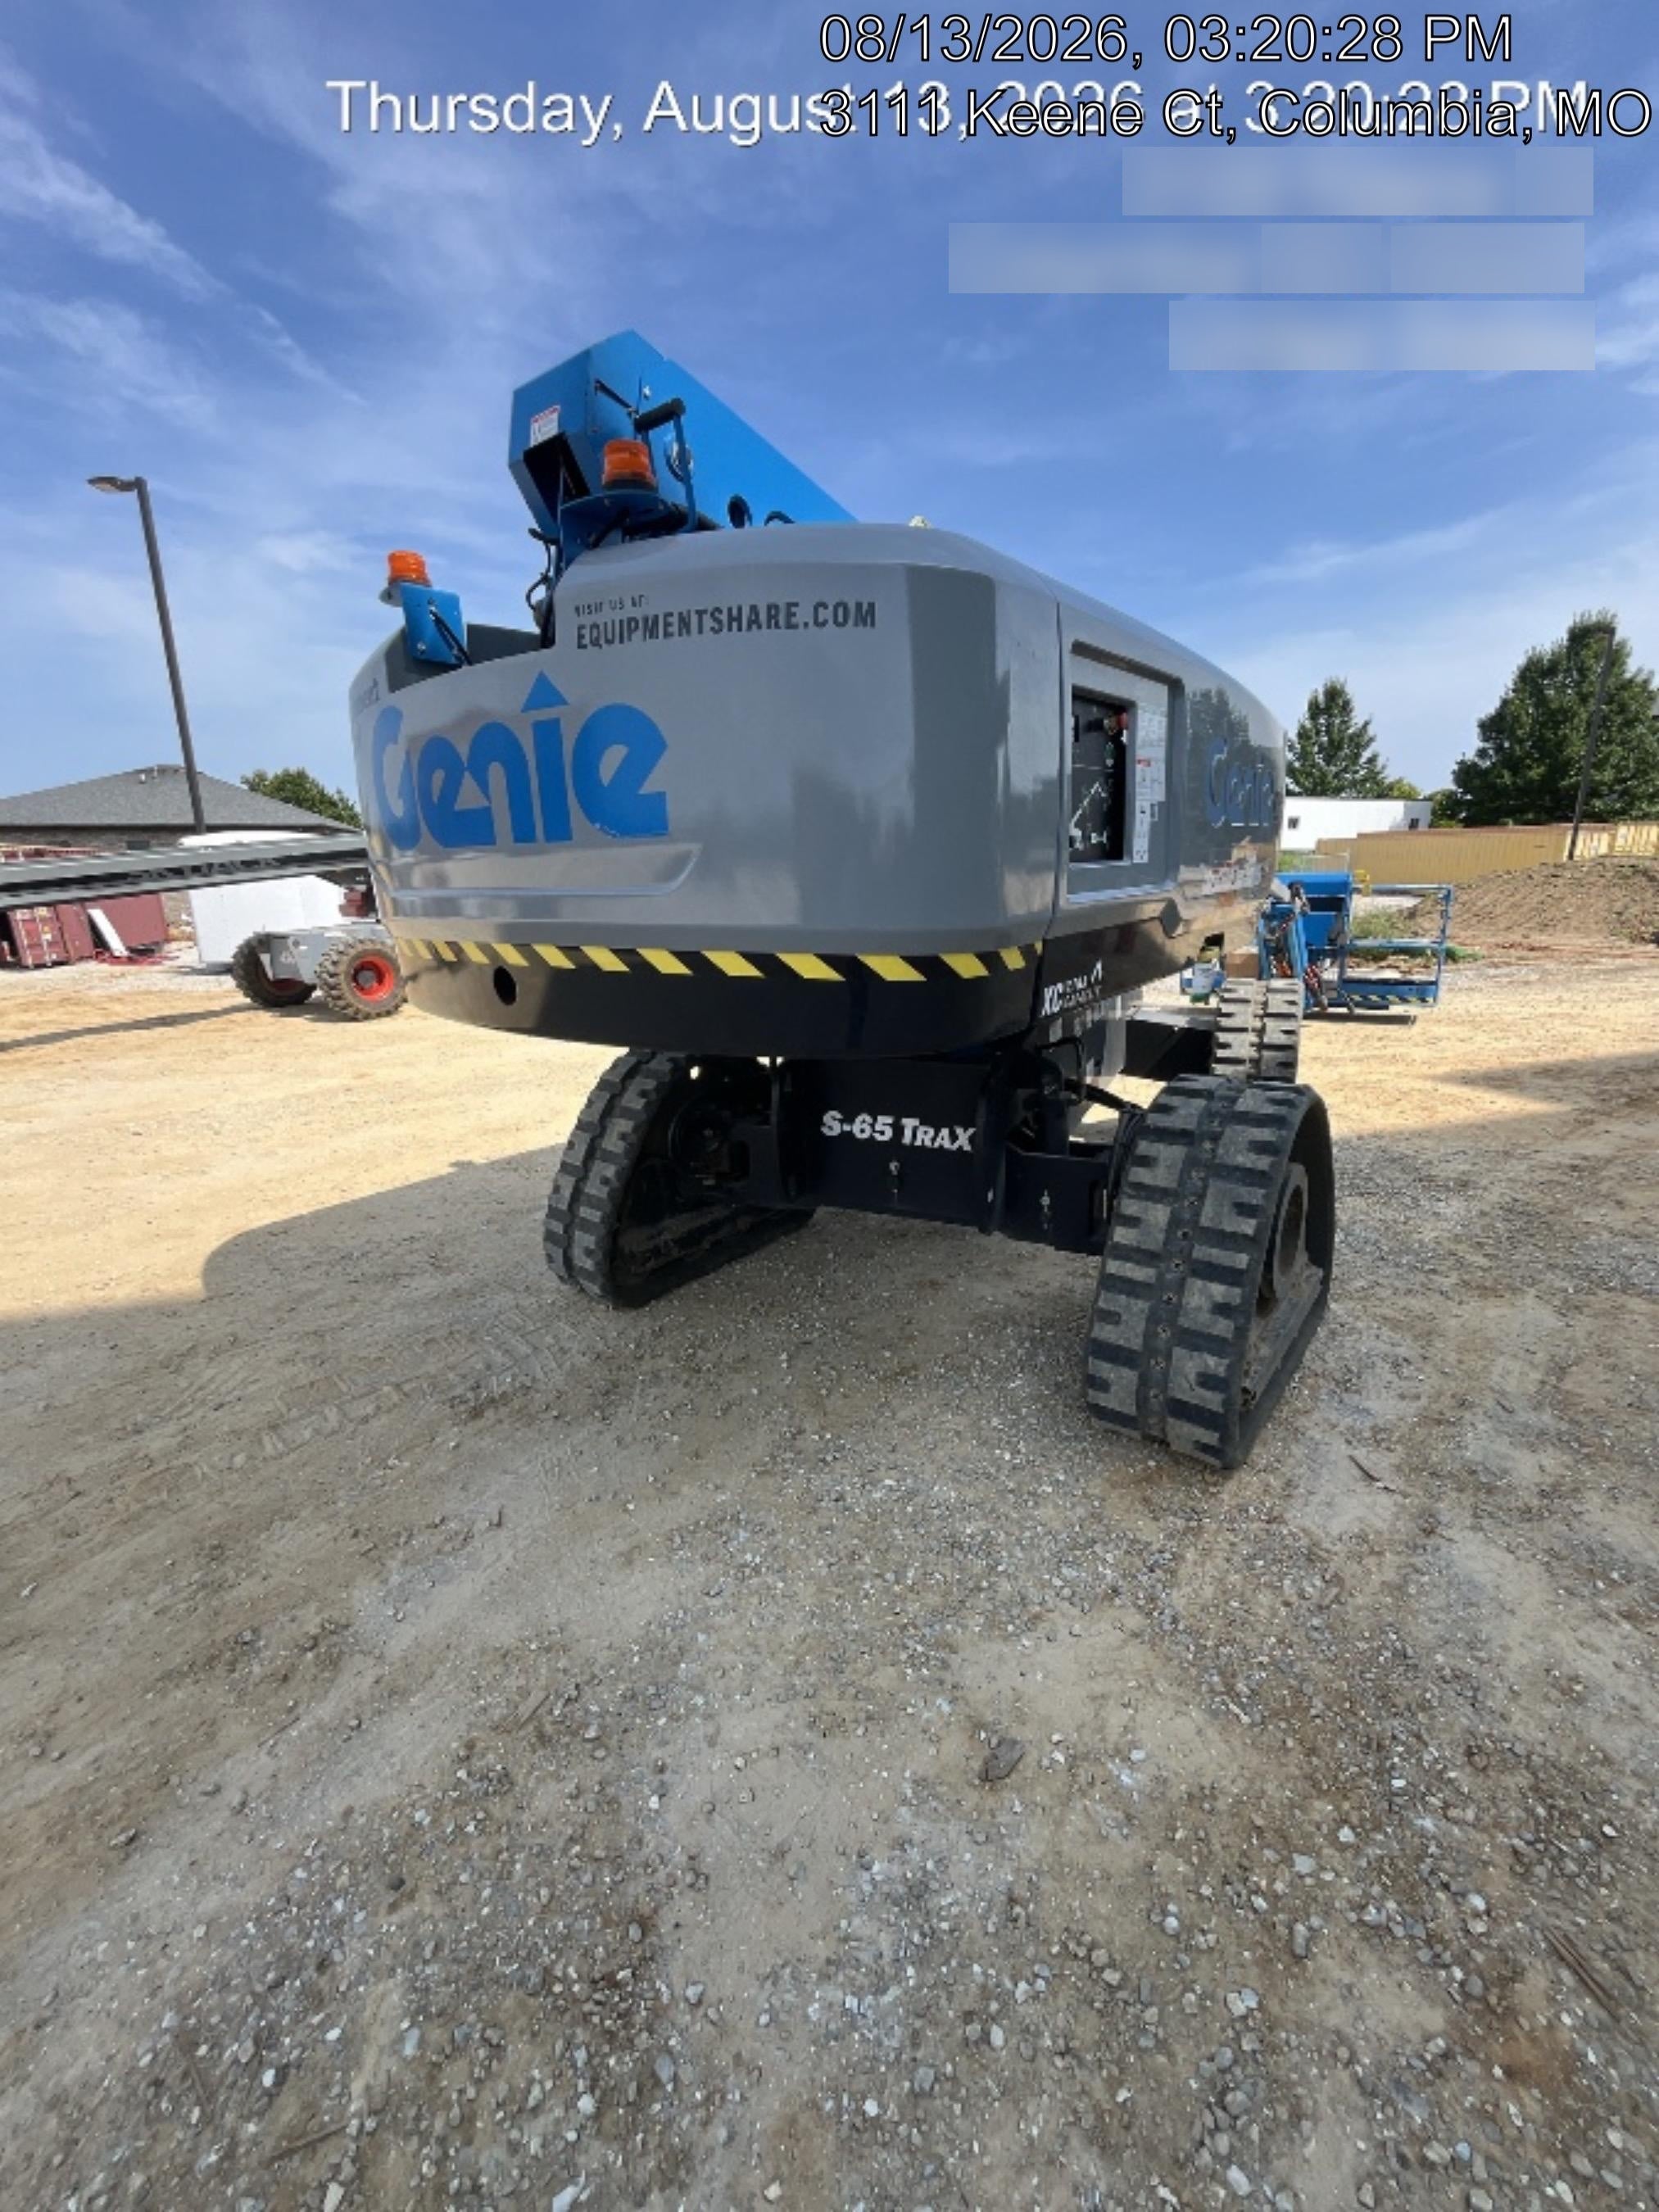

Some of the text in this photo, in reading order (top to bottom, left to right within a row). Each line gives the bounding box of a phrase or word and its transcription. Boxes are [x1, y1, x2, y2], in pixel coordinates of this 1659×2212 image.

[576, 600, 877, 650] EQUIPMENTSHARE.COM
[372, 670, 669, 850] Genie
[820, 1109, 895, 1142] S-65
